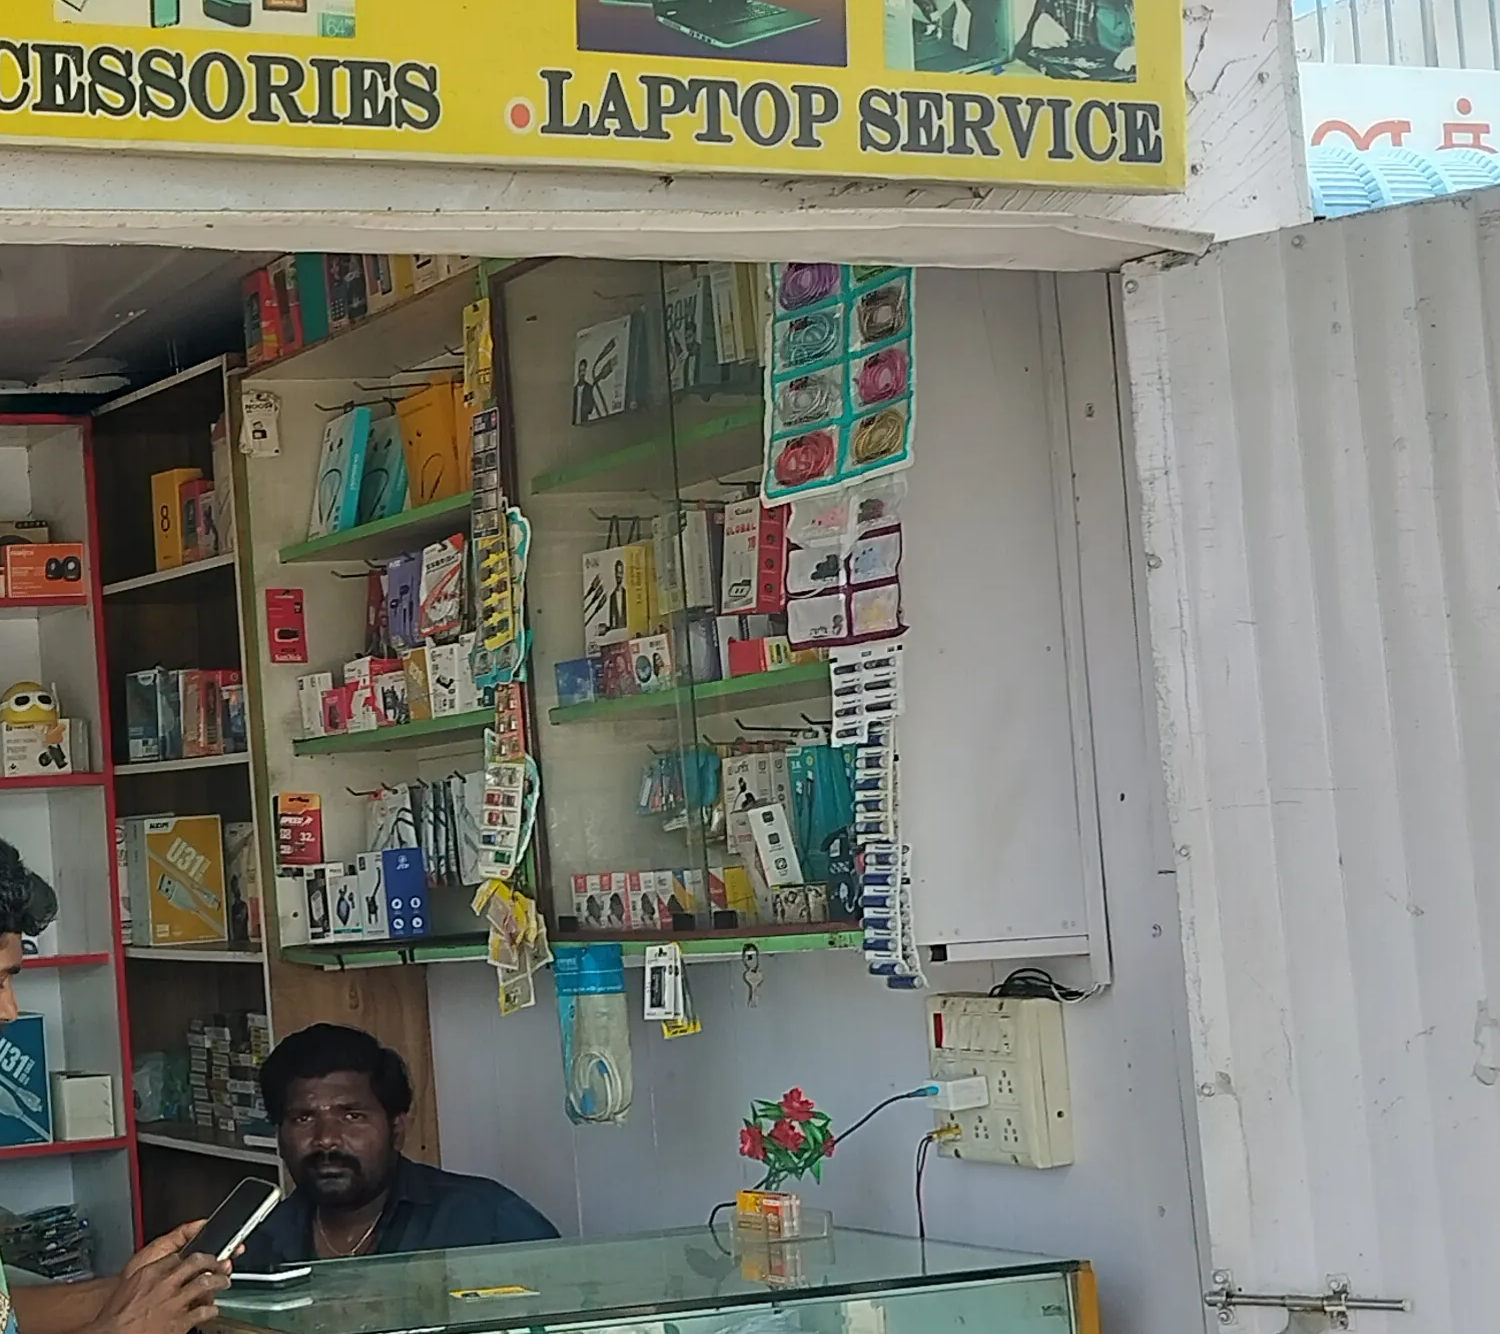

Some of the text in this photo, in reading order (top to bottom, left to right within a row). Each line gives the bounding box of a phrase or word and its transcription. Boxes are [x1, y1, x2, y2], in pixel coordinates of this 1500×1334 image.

[540, 68, 1164, 165] LAPTOP SERVICE
[160, 505, 171, 533] 8
